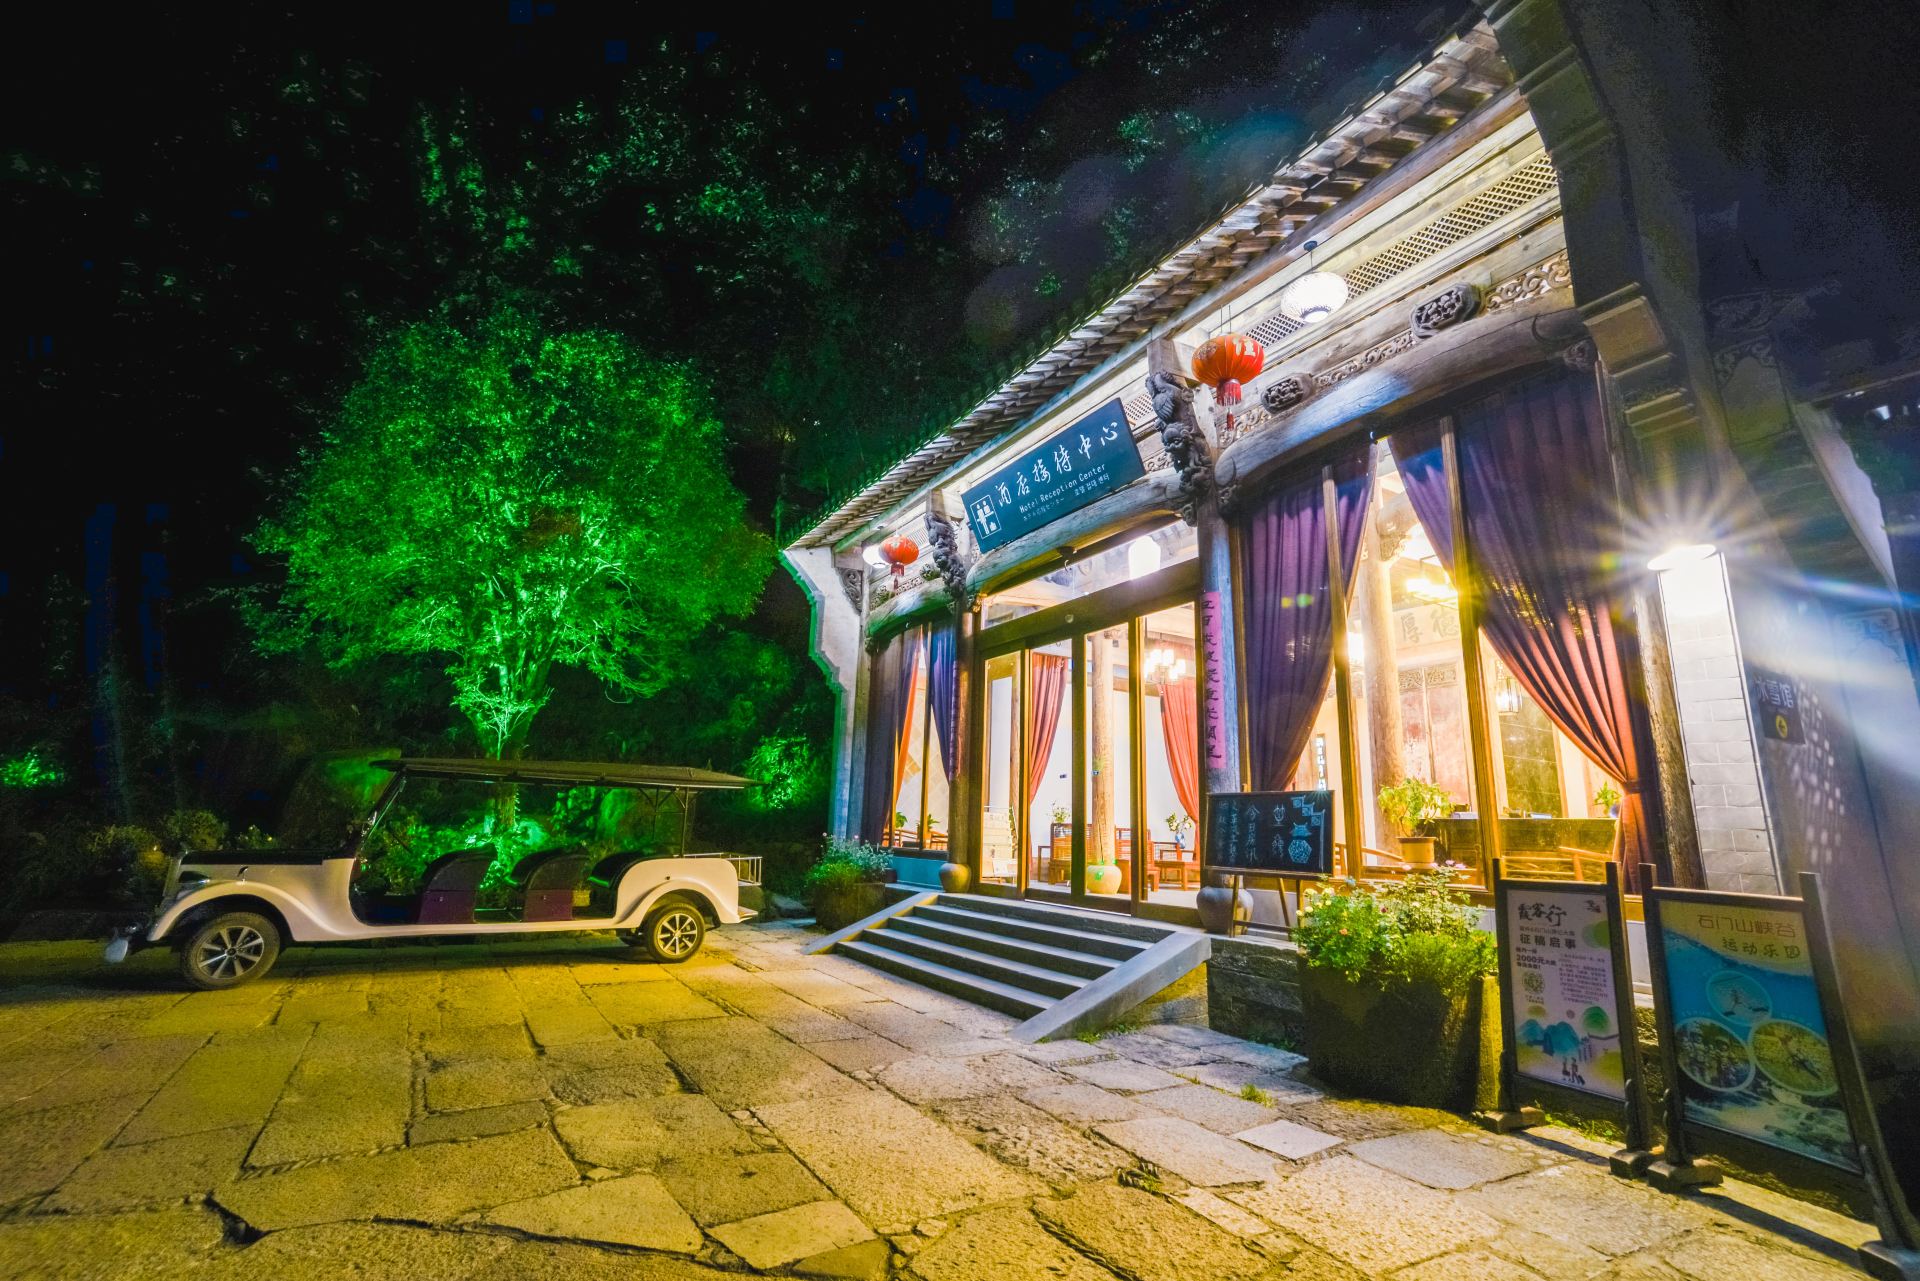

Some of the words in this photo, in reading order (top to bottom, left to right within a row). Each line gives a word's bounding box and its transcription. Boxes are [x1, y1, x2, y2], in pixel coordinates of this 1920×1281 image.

[995, 422, 1118, 507] 酒店接待中心
[1019, 498, 1039, 514] Hotel
[1040, 479, 1077, 502] Reception
[1078, 463, 1106, 482] Center
[1518, 902, 1567, 927] 霞客行
[1697, 914, 1796, 938] 石门山峡谷
[1520, 933, 1576, 950] 征稿启事
[1721, 936, 1801, 959] 运动乐园
